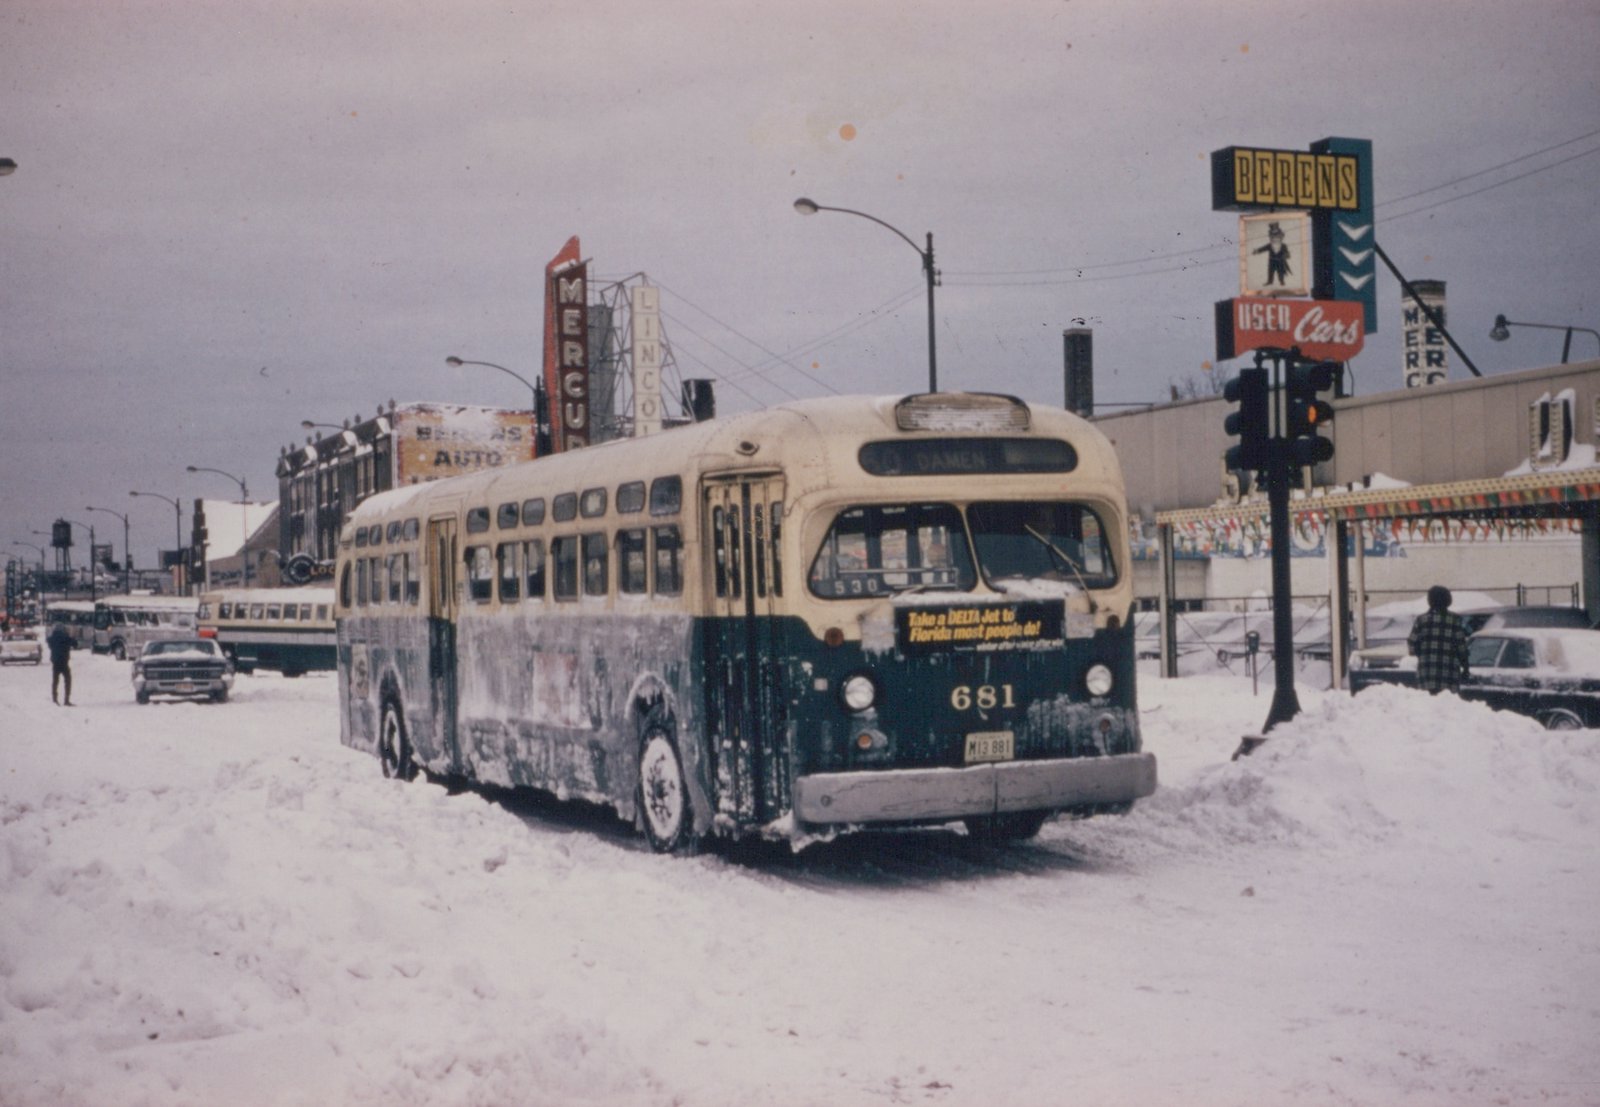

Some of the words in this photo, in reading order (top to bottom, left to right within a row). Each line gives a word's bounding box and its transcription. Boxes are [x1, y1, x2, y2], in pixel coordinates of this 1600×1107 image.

[1237, 156, 1354, 202] BERENS
[1238, 303, 1290, 331] USED
[1294, 306, 1360, 345] Cars
[434, 450, 503, 467] AUTO
[917, 450, 986, 470] DAMEN
[834, 579, 878, 595] 530
[908, 612, 936, 627] Take
[936, 613, 946, 625] a
[947, 609, 980, 625] DELTA
[982, 609, 1000, 623] Jet
[1003, 608, 1015, 622] to
[909, 626, 951, 642] Florida
[953, 624, 984, 639] most
[985, 623, 1022, 640] people
[1023, 621, 1041, 636] do!
[951, 684, 1016, 711] 681
[968, 740, 989, 756] M13
[992, 739, 1010, 754] 881
